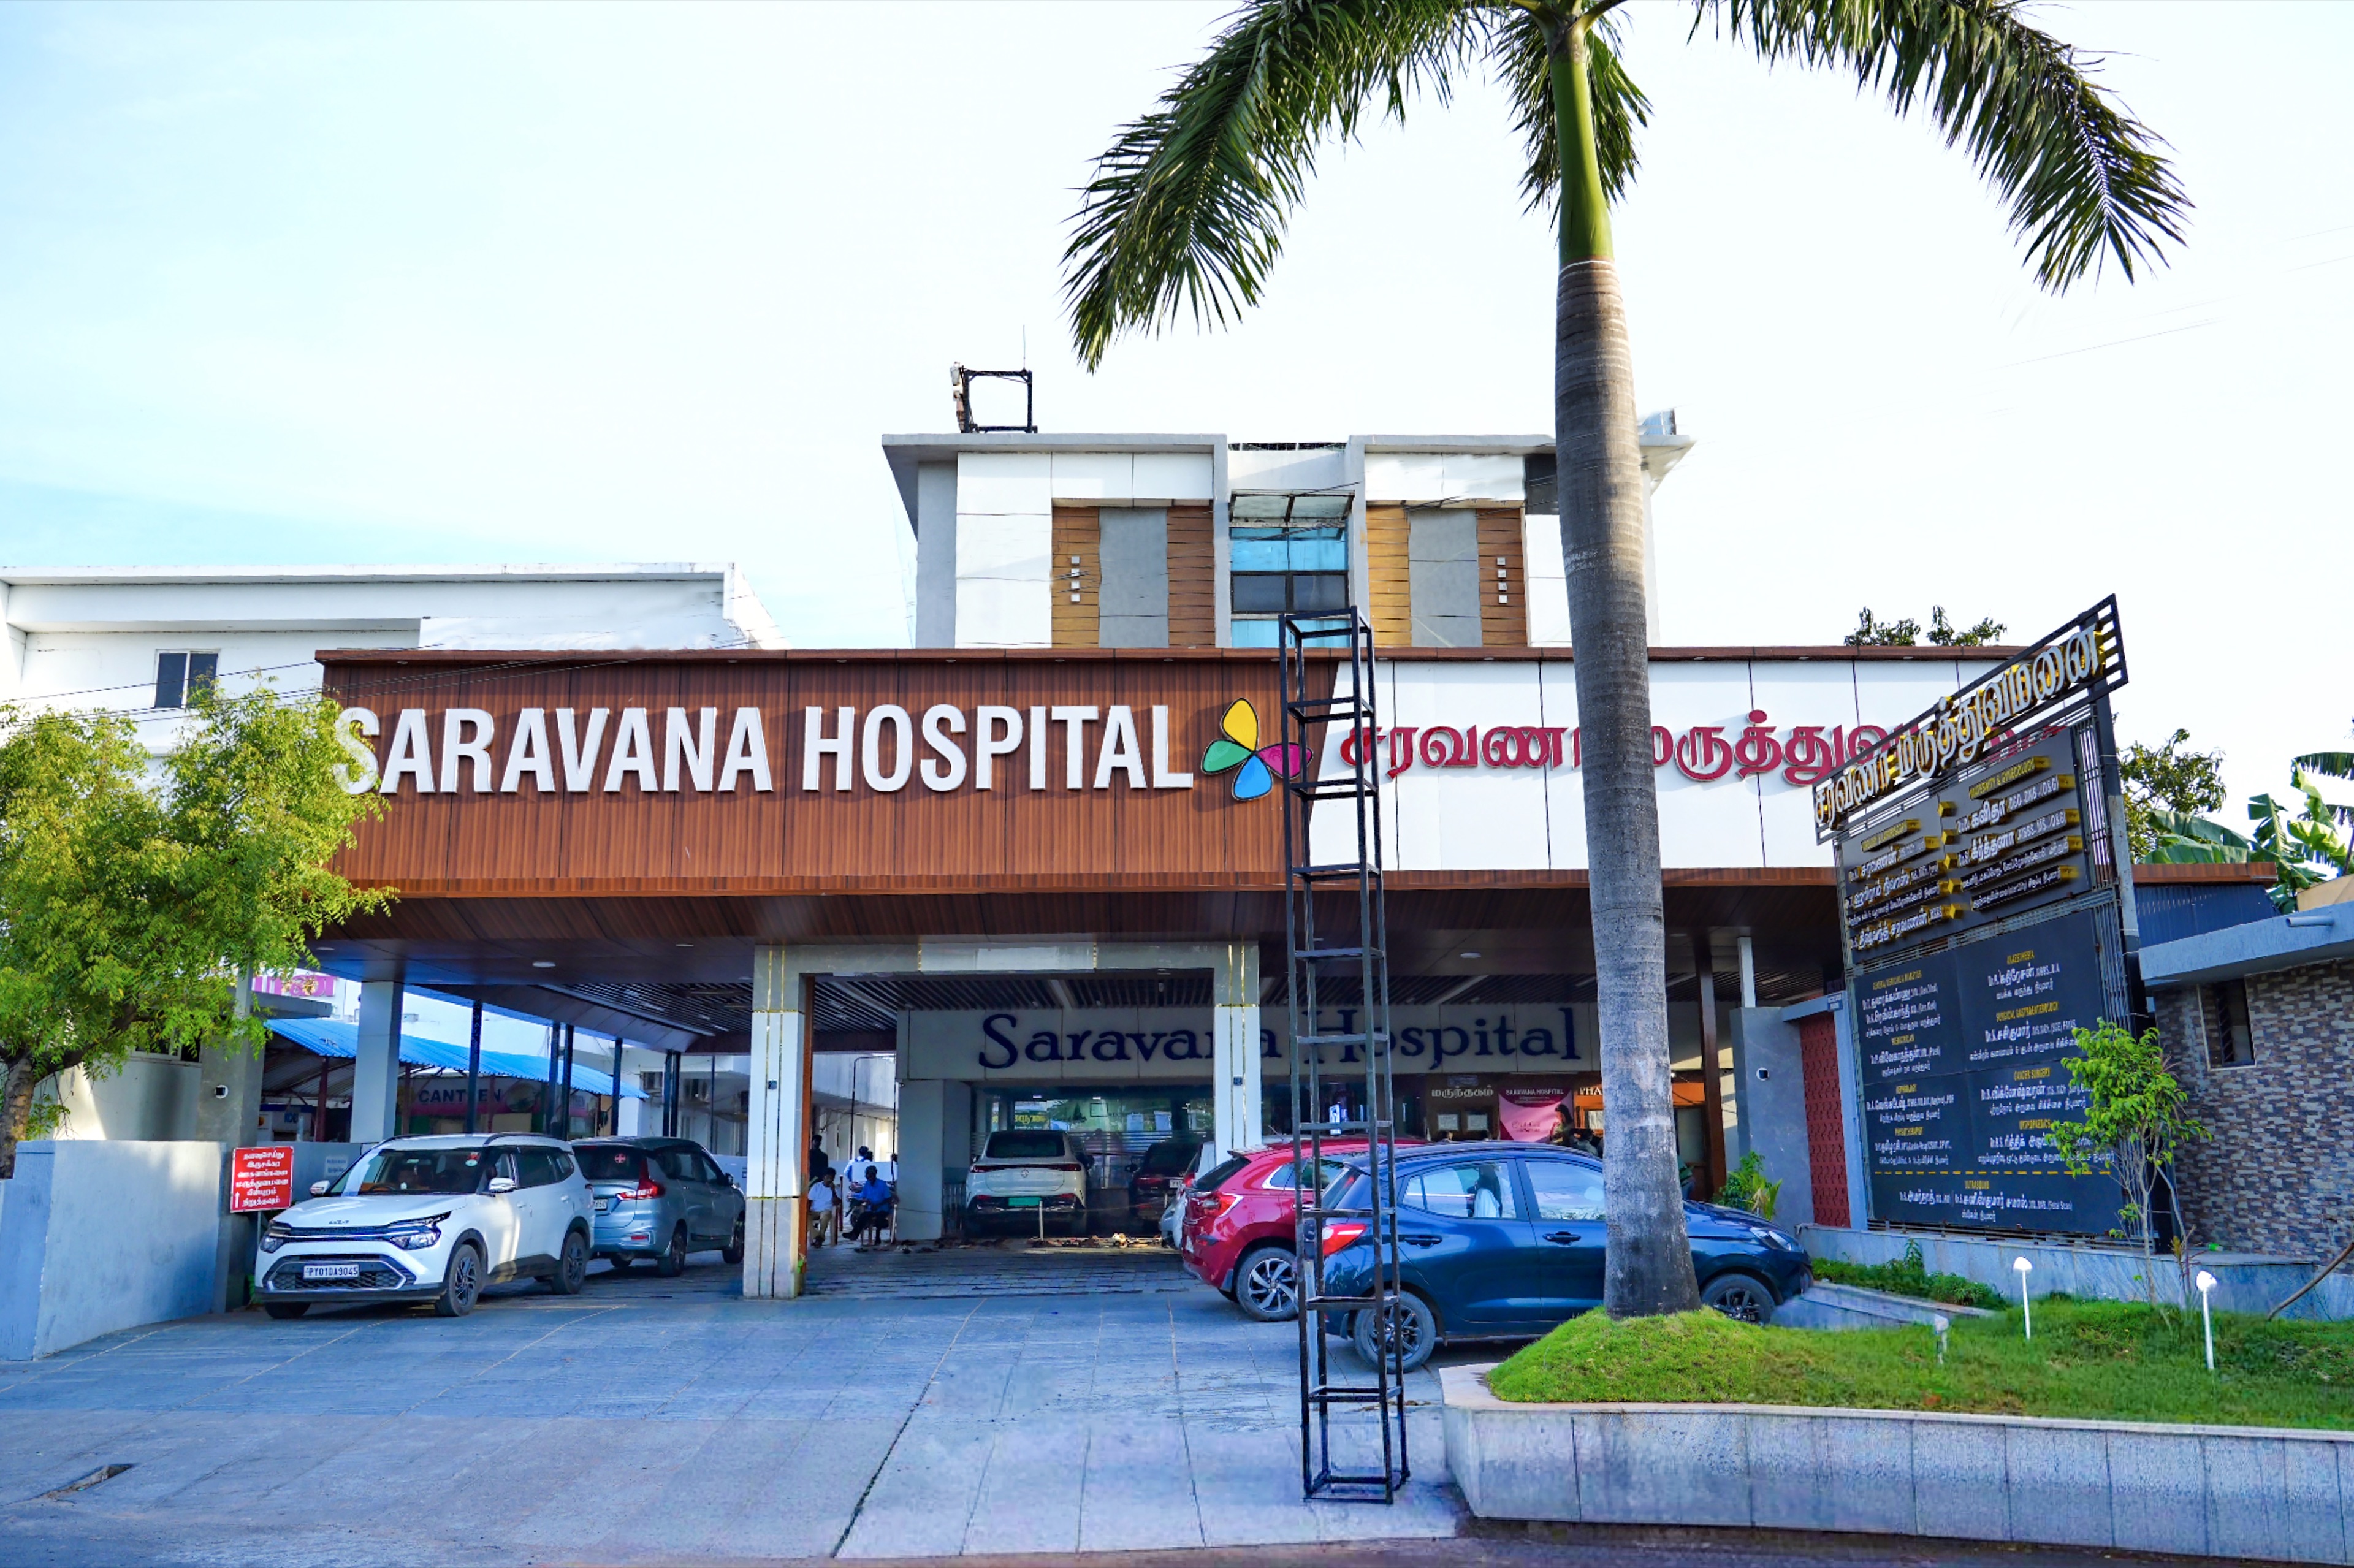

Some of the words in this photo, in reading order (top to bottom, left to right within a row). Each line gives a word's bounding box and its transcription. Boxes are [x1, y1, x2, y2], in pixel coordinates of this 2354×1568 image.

[333, 707, 774, 794] SARAVANA
[802, 703, 1194, 793] HOSPITAL
[1814, 752, 1894, 830] சரவணா
[1897, 623, 2100, 778] மருத்துவமனை
[978, 1013, 1282, 1069] Saravaa
[419, 1088, 501, 1103] CANTEN
